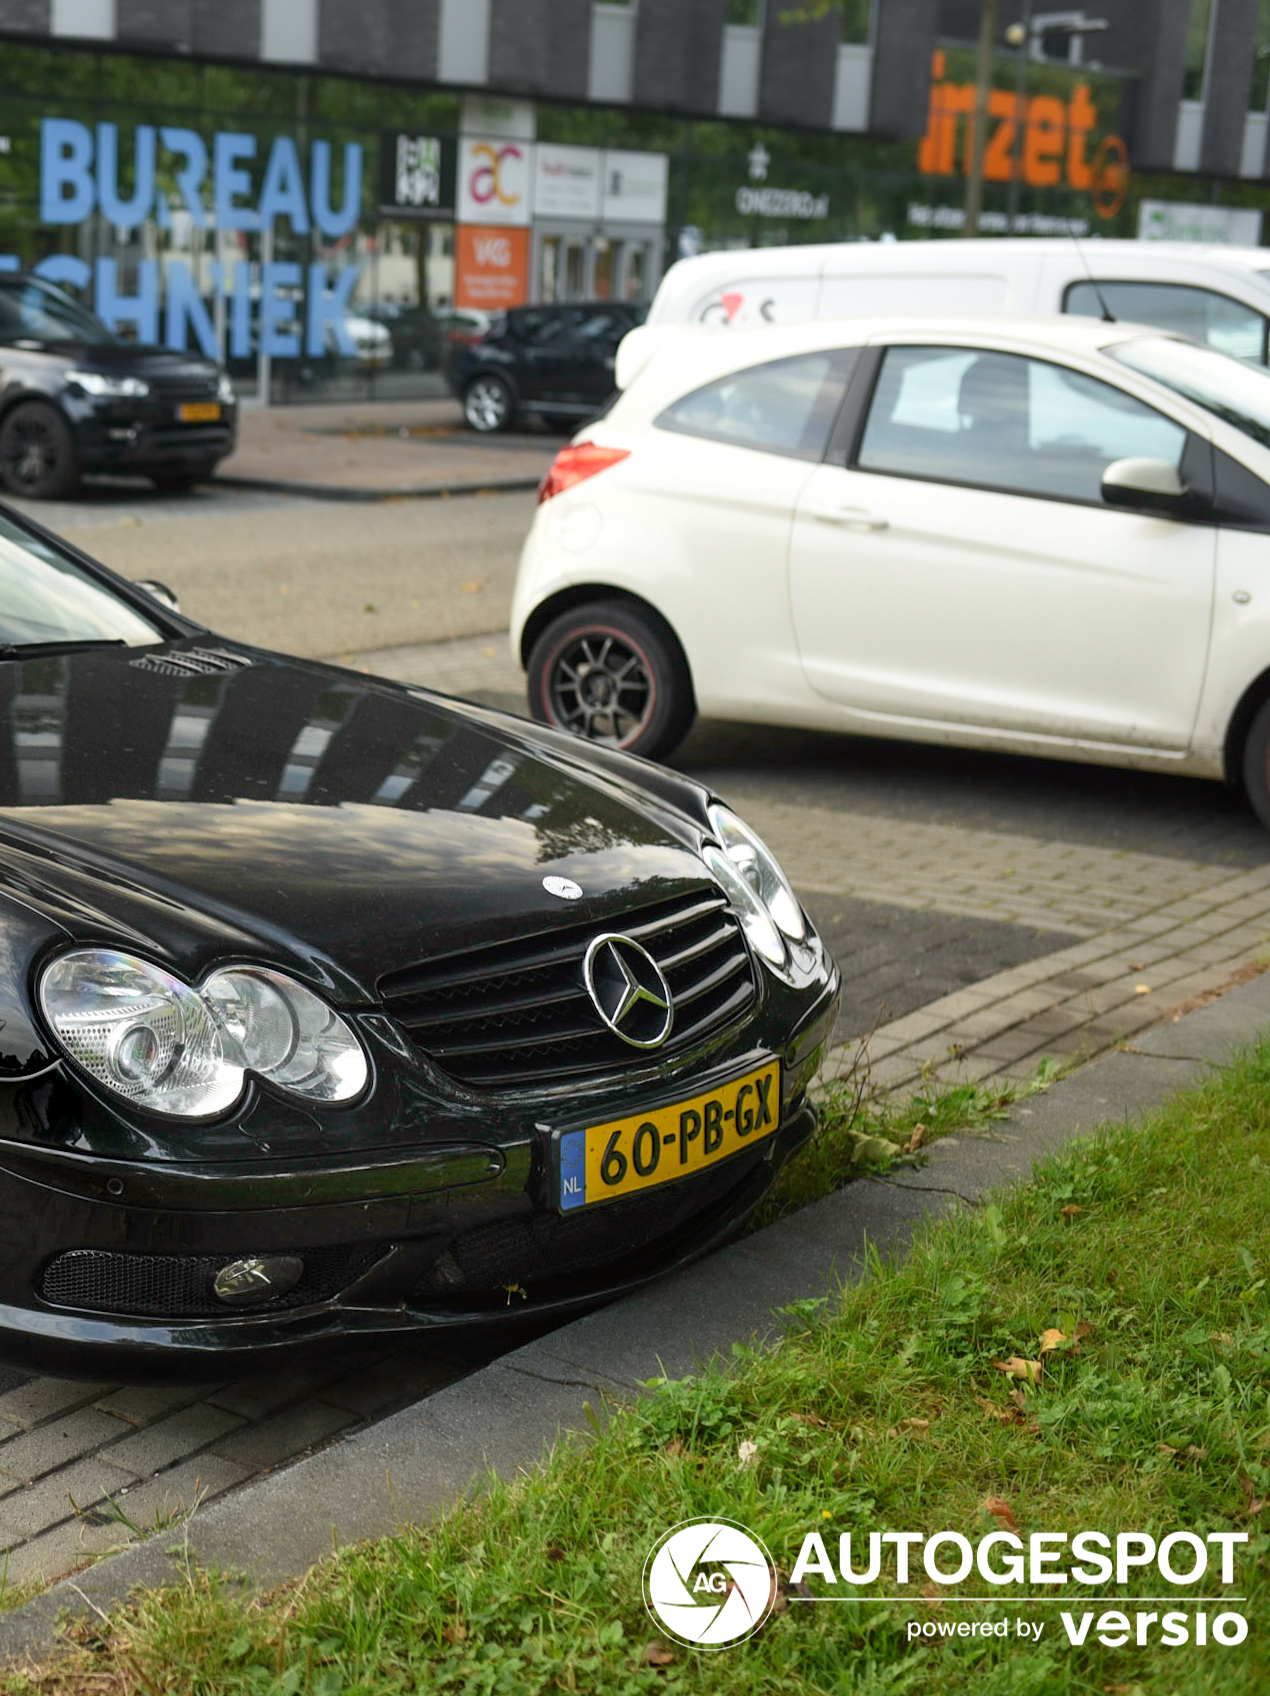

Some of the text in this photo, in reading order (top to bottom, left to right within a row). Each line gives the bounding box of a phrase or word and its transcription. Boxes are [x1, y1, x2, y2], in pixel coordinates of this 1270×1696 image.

[40, 117, 364, 236] BUREAU
[563, 1176, 582, 1196] NL
[600, 1073, 772, 1186] 60-PB-GX
